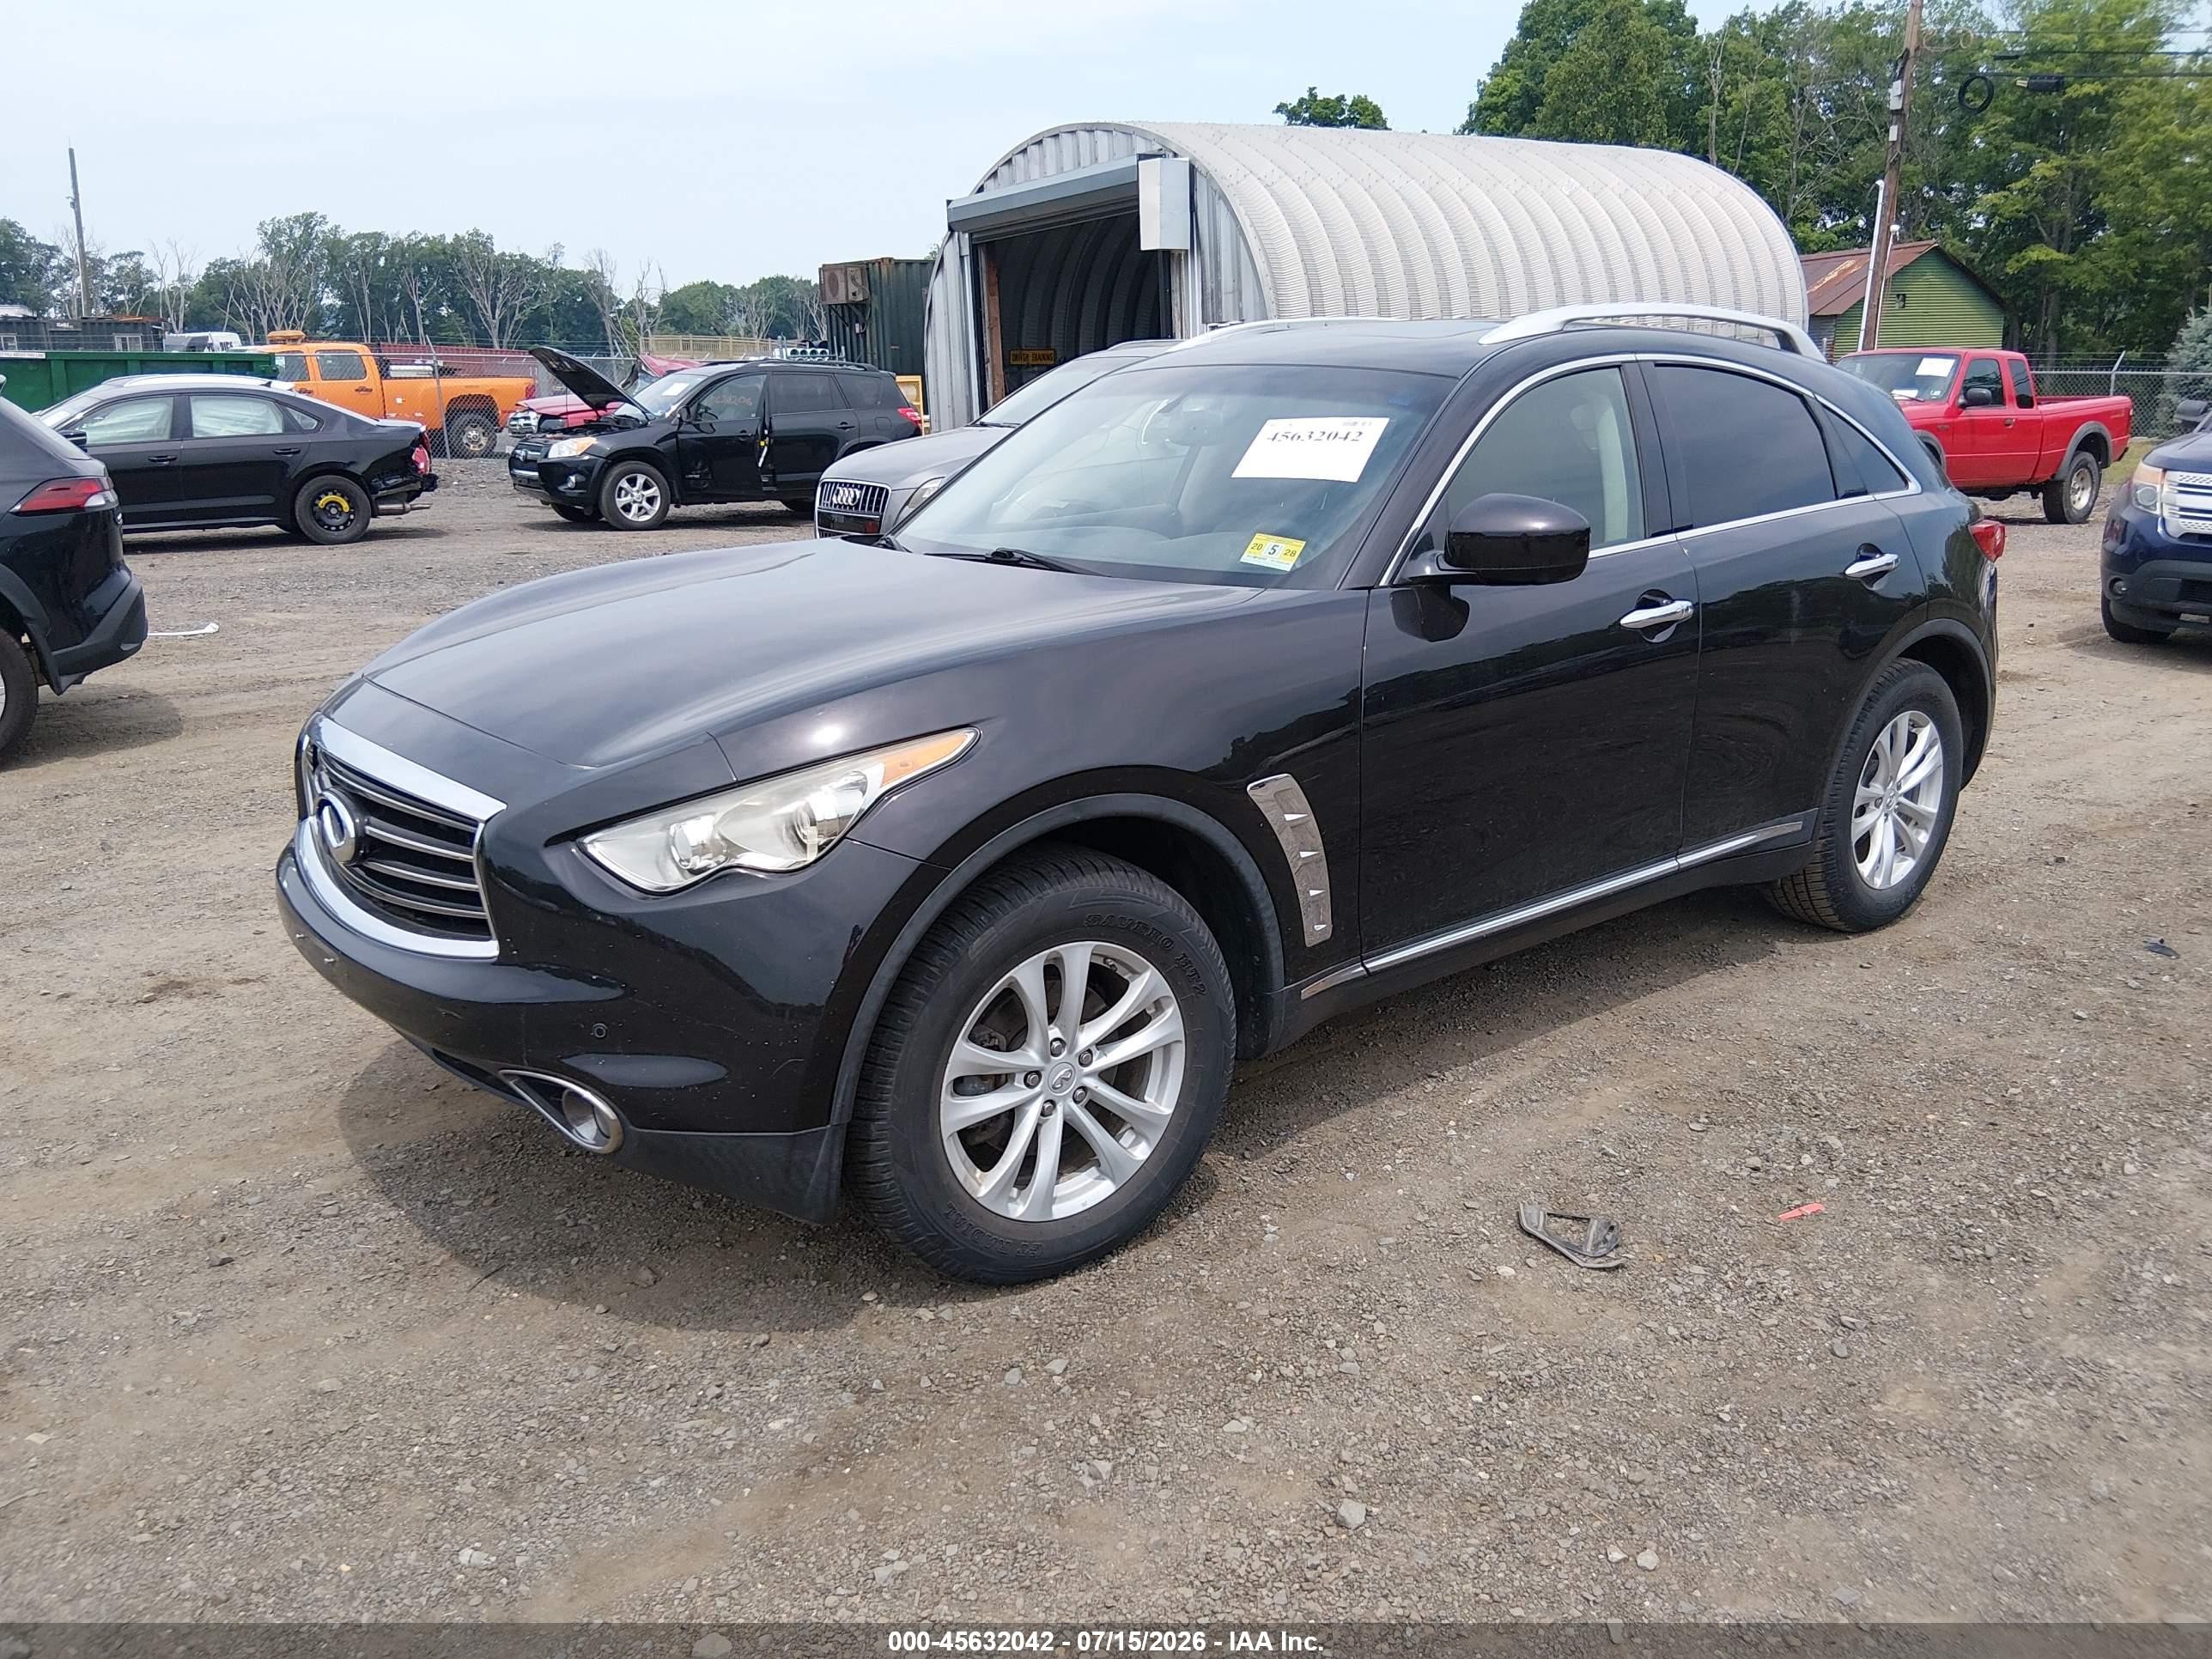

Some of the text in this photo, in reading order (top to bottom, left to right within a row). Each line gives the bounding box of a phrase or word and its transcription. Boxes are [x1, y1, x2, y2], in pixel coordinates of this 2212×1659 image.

[1267, 430, 1363, 442] 45632042
[1251, 543, 1297, 557] 20 5 28
[1085, 914, 1175, 951] SAVERO
[943, 1200, 1012, 1257] RADIAL
